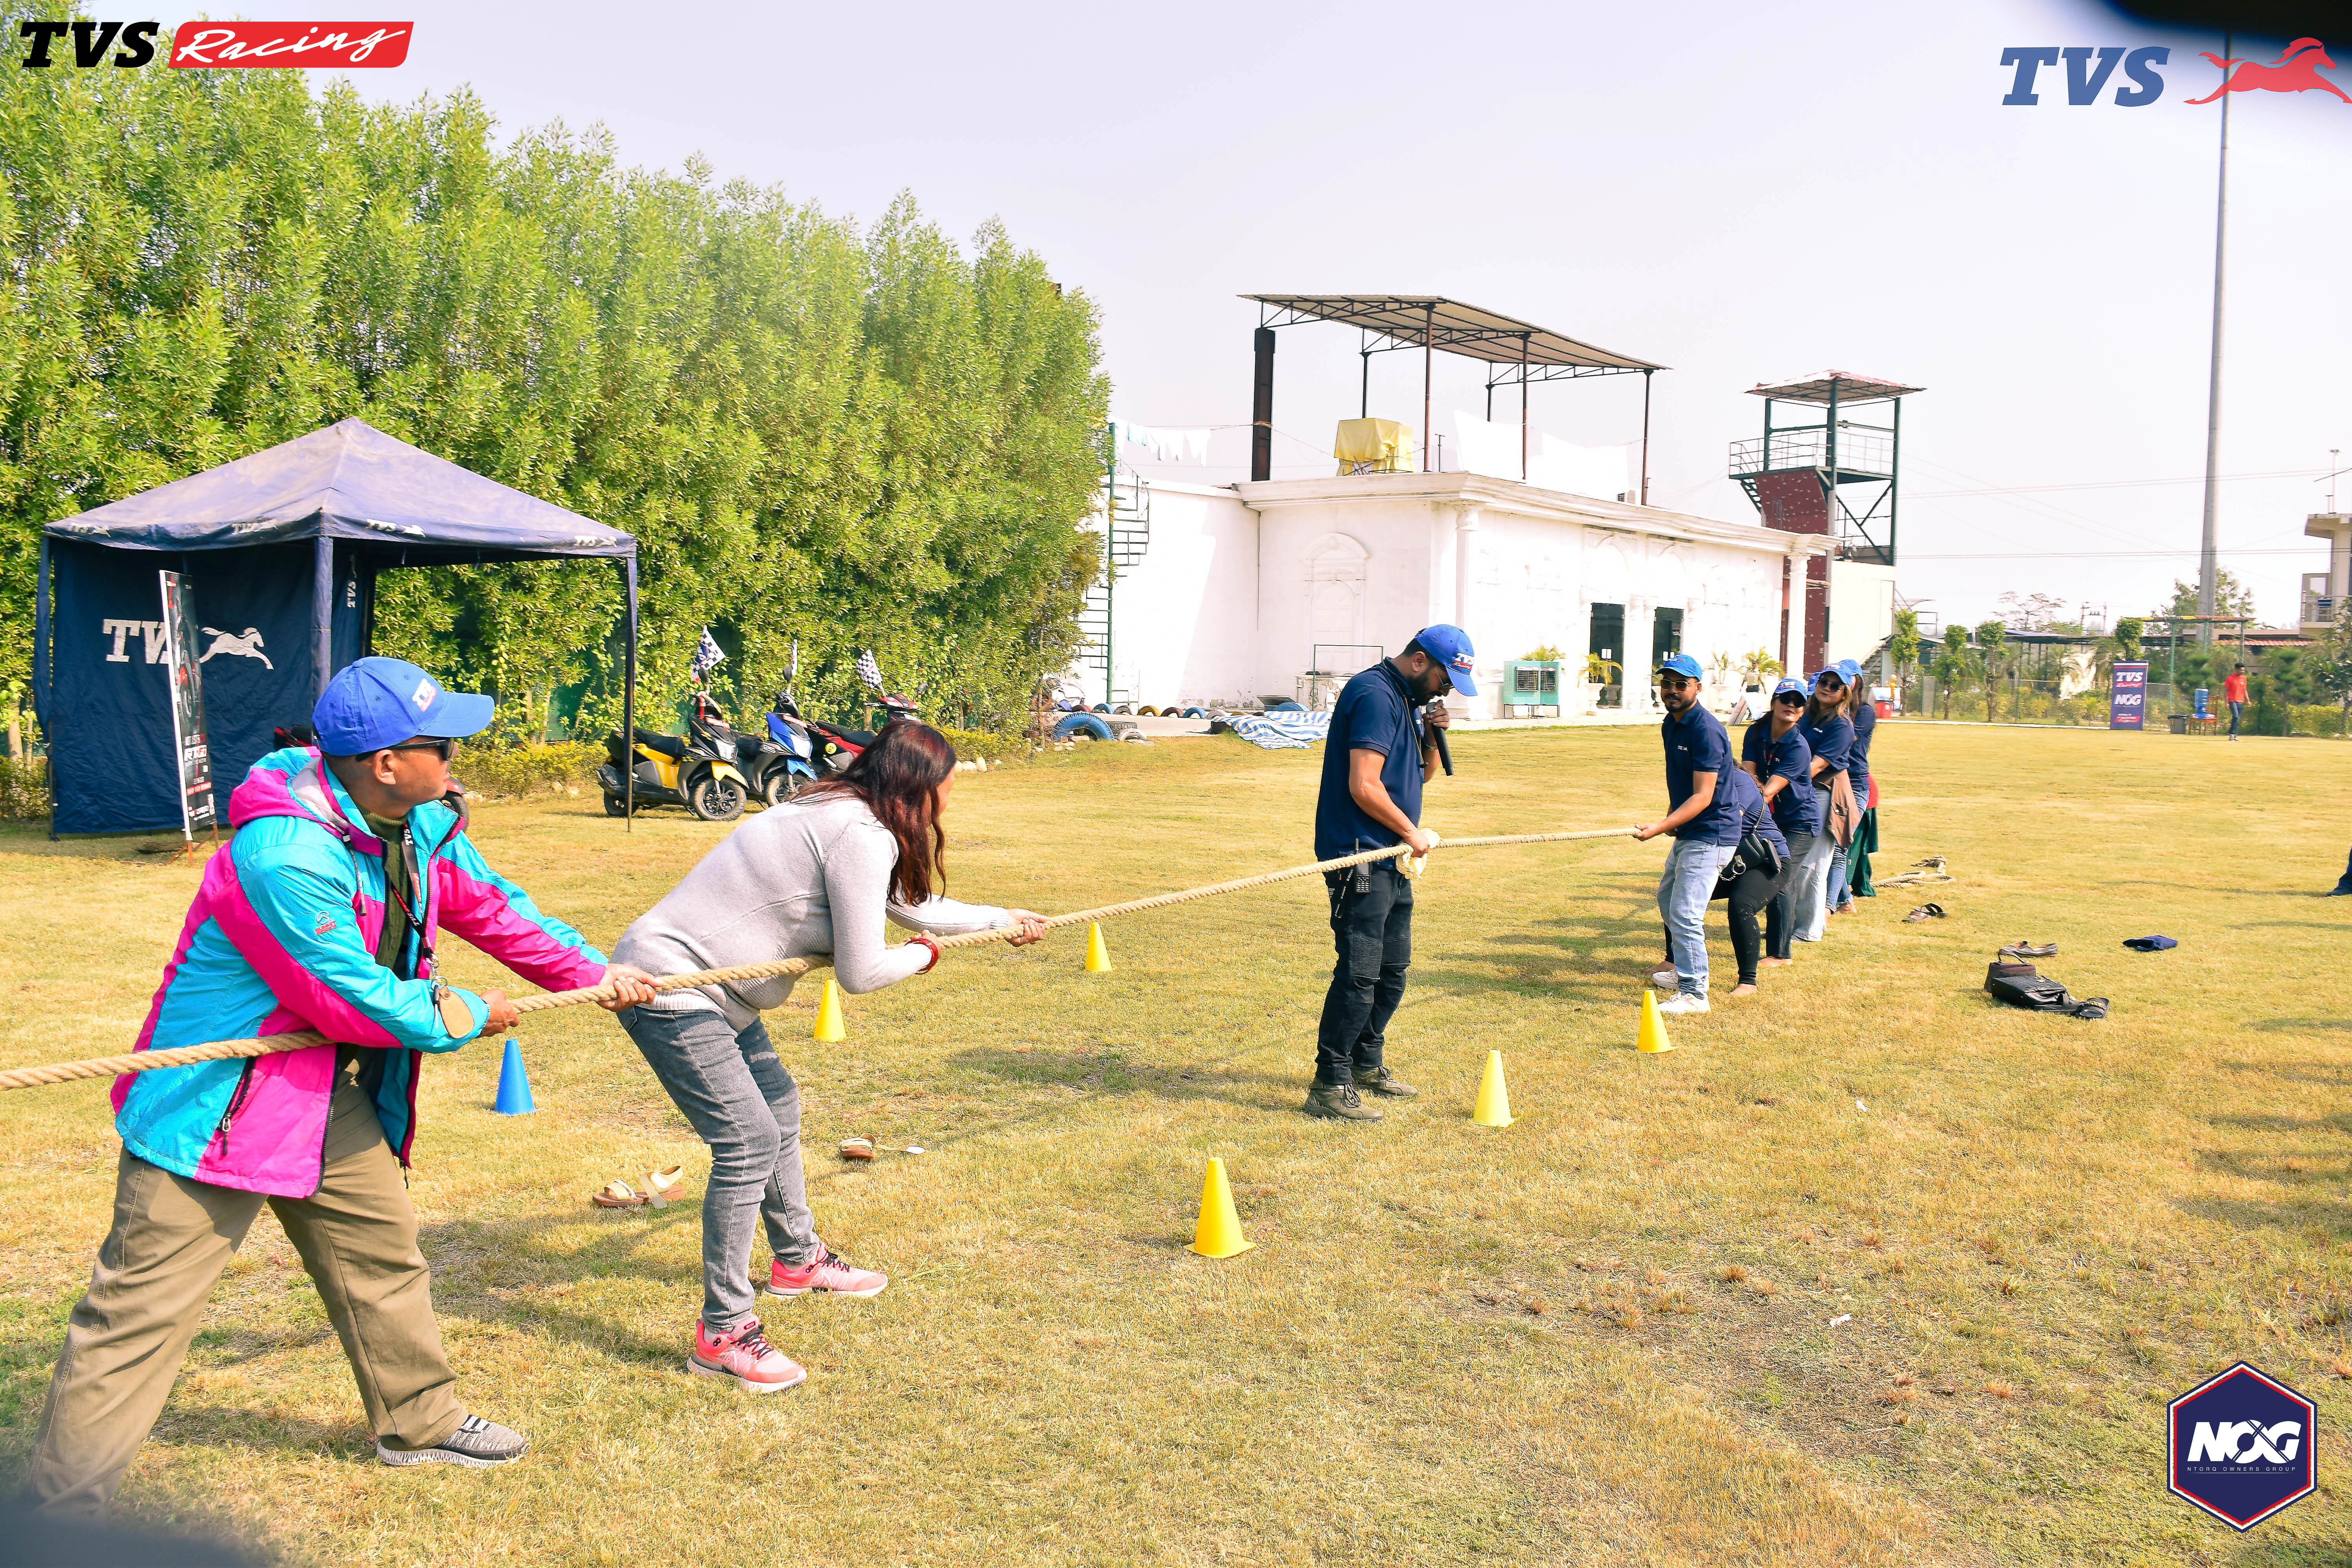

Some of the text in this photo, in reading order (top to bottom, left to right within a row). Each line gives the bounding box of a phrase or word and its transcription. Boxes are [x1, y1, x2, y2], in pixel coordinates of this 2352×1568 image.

[347, 581, 356, 608] TVS
[102, 619, 169, 664] TV
[2116, 672, 2143, 682] TVS
[403, 828, 414, 846] TVS
